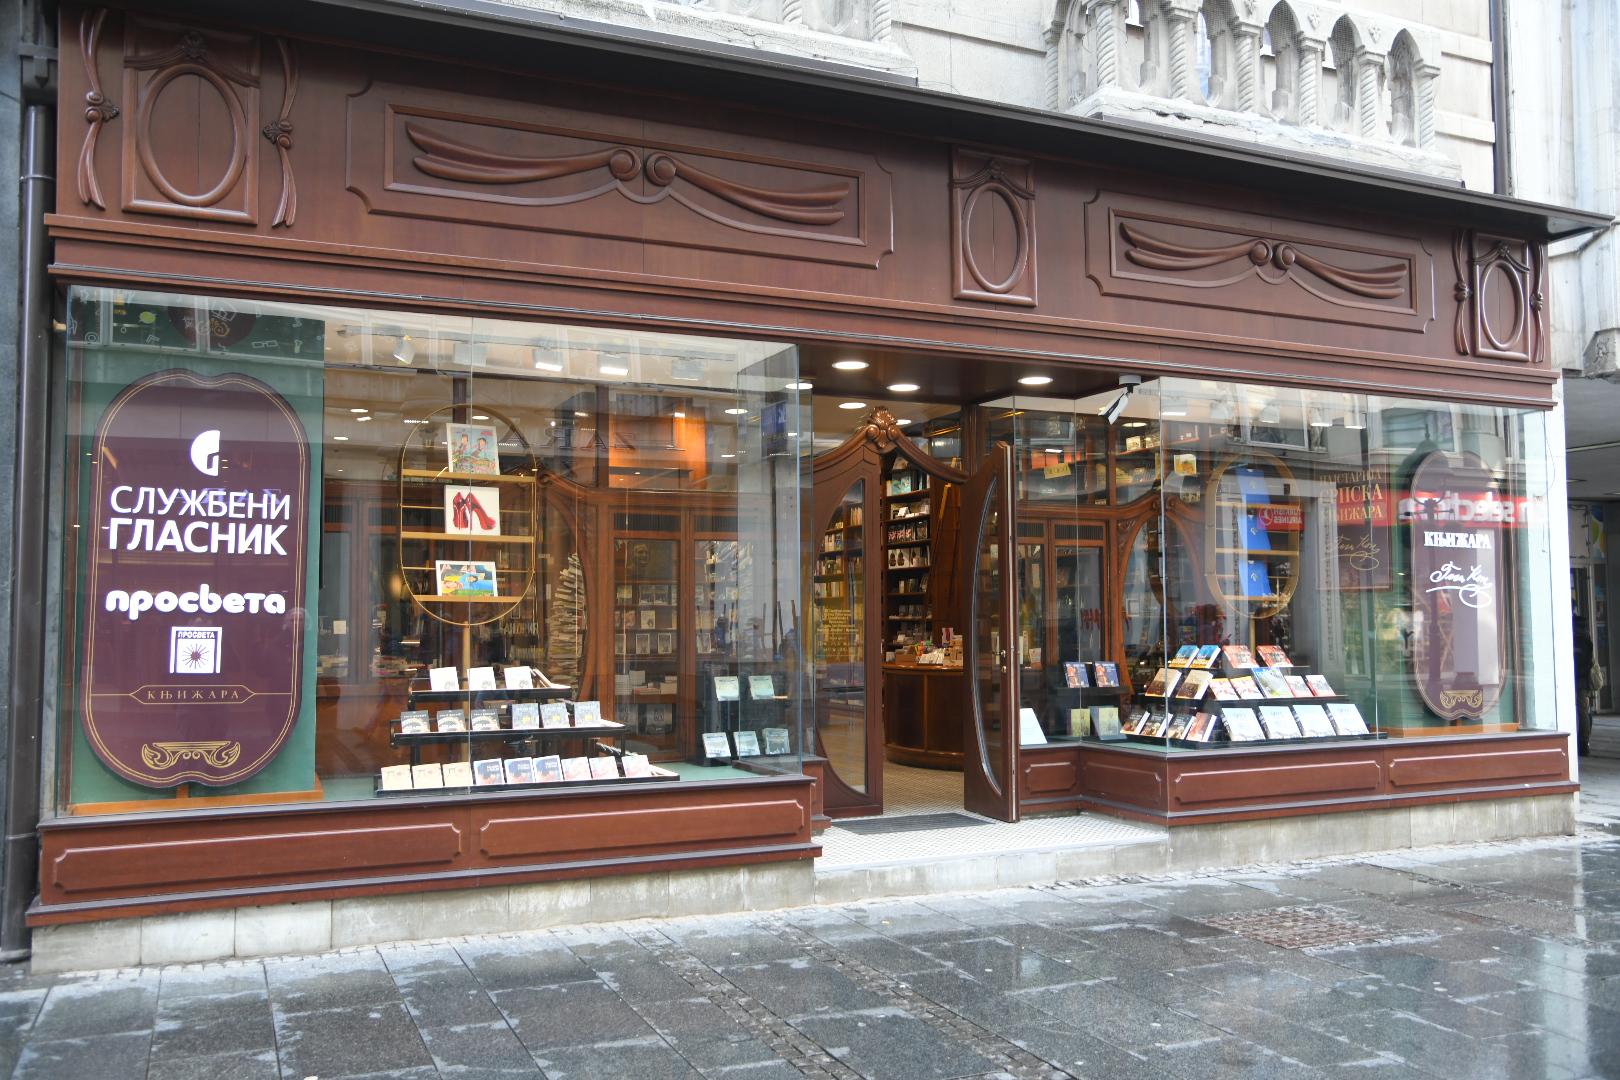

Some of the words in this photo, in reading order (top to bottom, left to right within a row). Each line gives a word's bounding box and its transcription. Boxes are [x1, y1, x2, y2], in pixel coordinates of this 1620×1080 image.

[110, 485, 291, 520] СЛУЖБЕНИ
[1319, 483, 1384, 506] СРПСКА
[1321, 505, 1383, 522] КЊИЖАРА
[108, 518, 288, 556] ГЛАСНИК
[1423, 531, 1492, 549] КЊИЖАРА
[105, 584, 286, 621] просвета
[177, 631, 215, 639] ПРОСВЕТА
[147, 690, 239, 700] КЊИЖАРА
